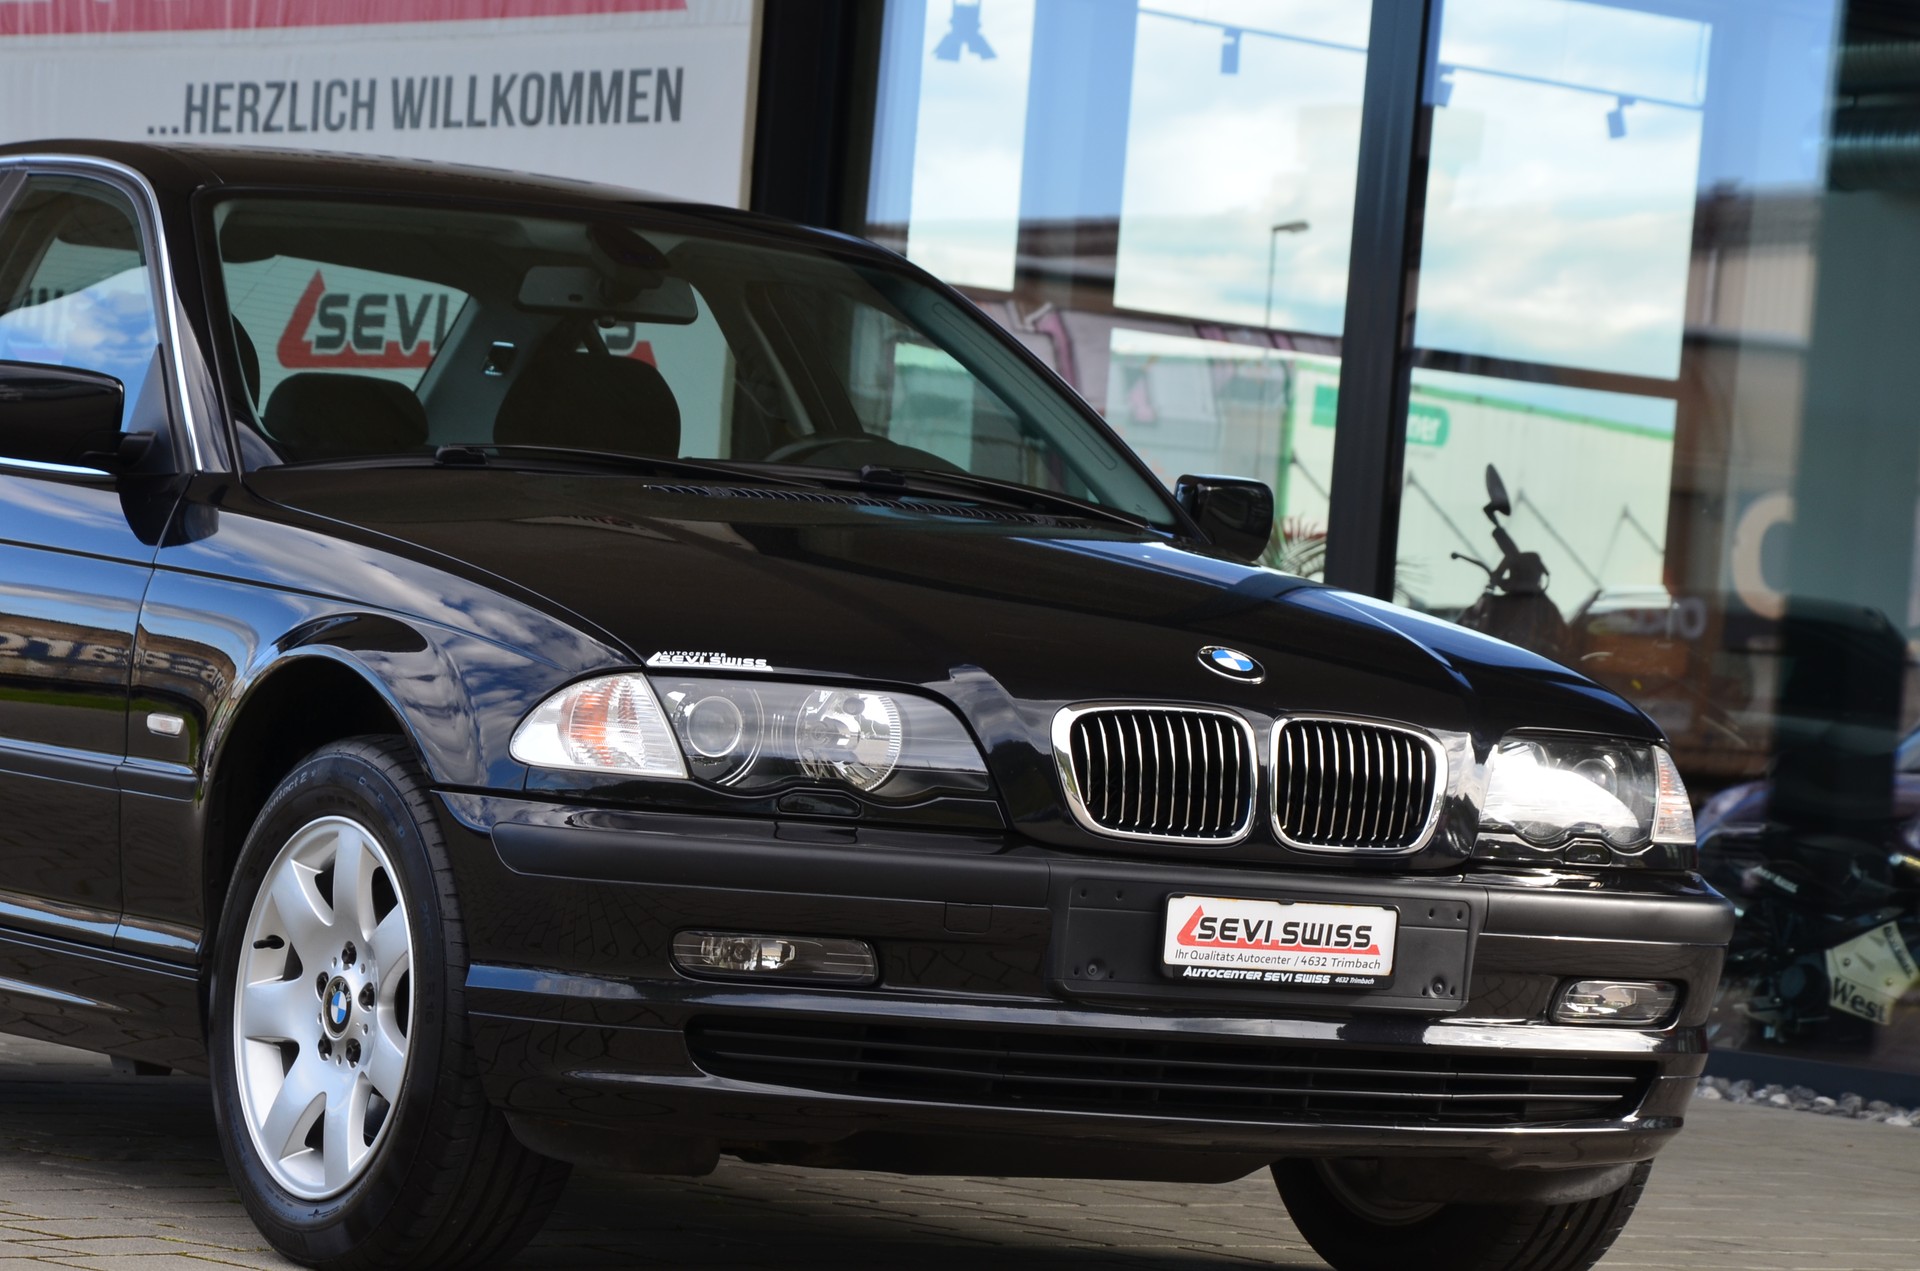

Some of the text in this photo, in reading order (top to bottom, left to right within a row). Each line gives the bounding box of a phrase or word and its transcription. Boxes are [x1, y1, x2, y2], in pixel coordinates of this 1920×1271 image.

[147, 66, 684, 135] ...HERZLICH WILLKOMMEN
[314, 292, 450, 352] SEVI
[659, 654, 767, 668] SEVI SWISS
[1197, 916, 1372, 948] SEVI SWISS
[1175, 949, 1188, 959] Ihr
[1236, 953, 1291, 965] Autocenter
[1331, 957, 1381, 970] Trimbach
[1263, 972, 1293, 983] SEVI
[1294, 973, 1331, 984] SWISS
[1335, 976, 1349, 984] 4632
[1349, 977, 1375, 985] Trimbach
[1833, 976, 1887, 1022] West
